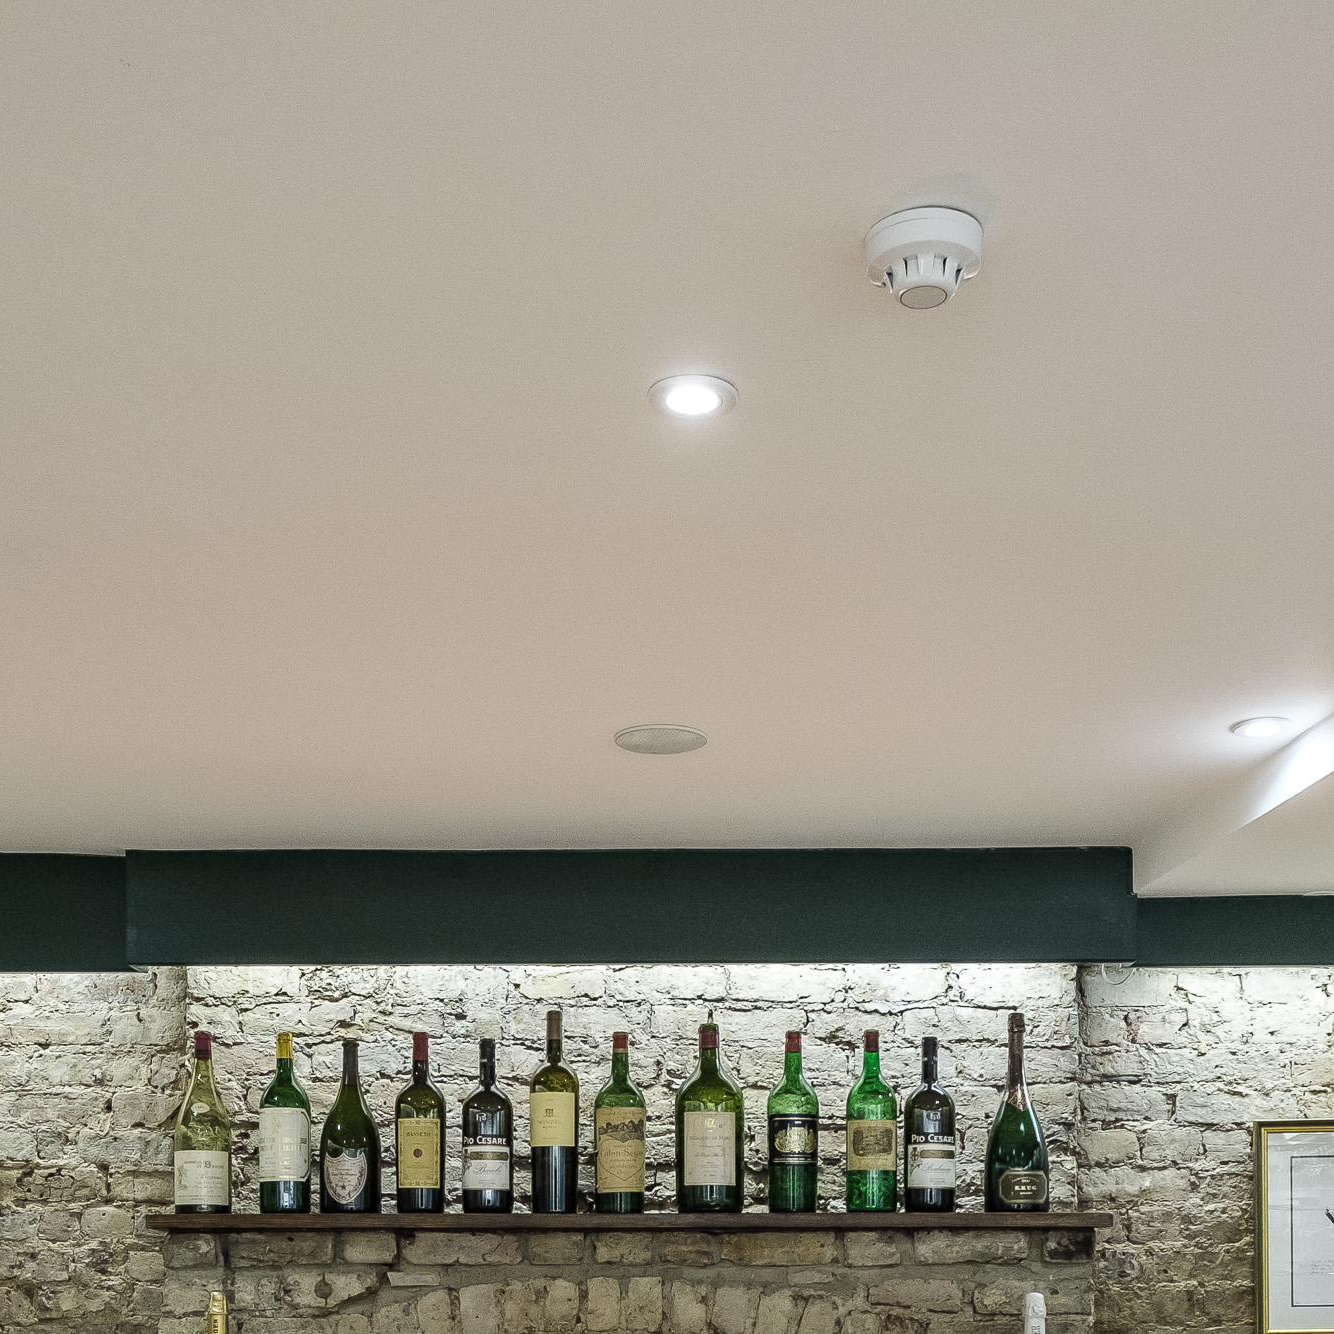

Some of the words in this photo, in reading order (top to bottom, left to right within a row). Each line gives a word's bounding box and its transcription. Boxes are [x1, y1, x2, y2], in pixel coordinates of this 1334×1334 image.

[463, 1136, 474, 1144] PIO
[476, 1135, 507, 1145] CESARE
[911, 1134, 925, 1143] PIO
